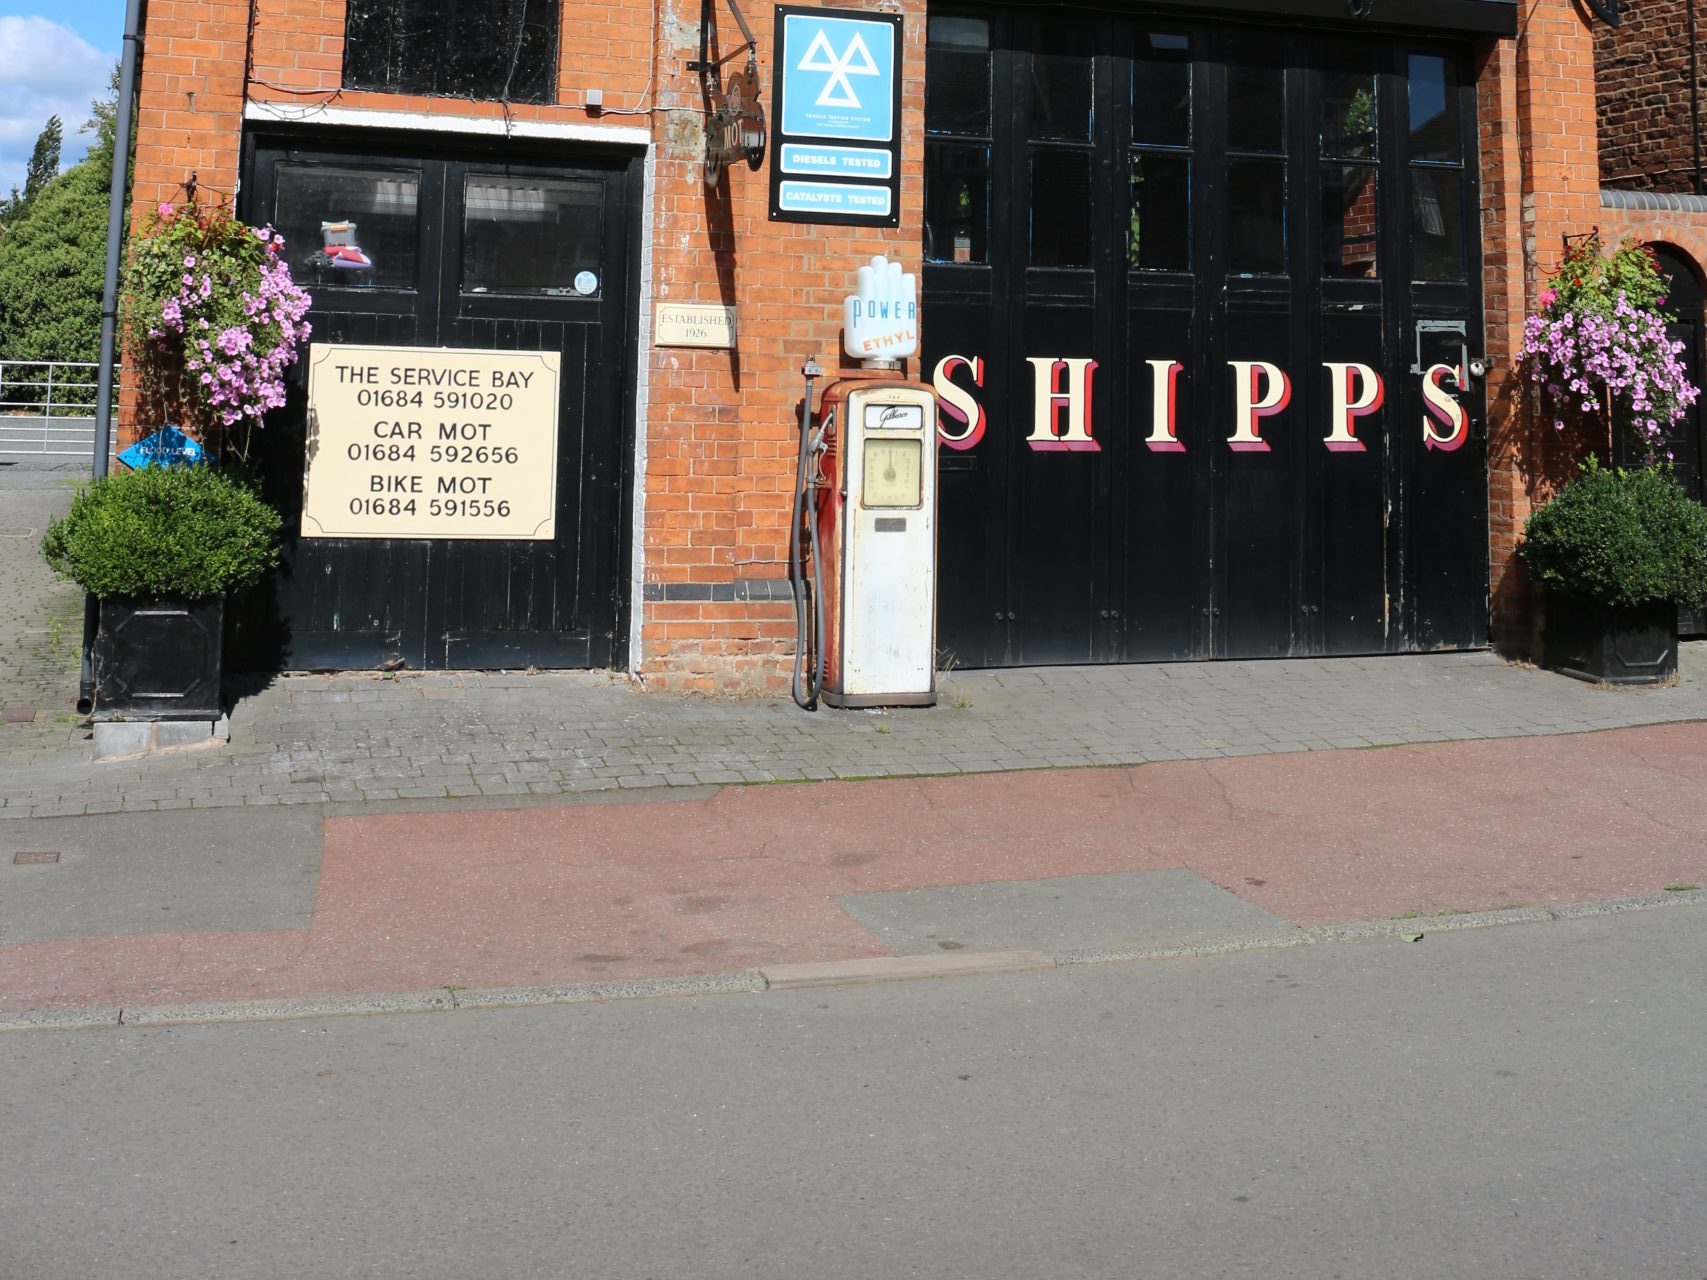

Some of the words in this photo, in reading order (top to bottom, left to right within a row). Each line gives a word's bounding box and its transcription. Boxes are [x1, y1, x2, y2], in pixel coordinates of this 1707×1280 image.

[724, 119, 744, 150] MOT
[792, 154, 837, 166] DIESELS
[842, 157, 881, 168] TESTED
[785, 191, 842, 203] CATALYSTS
[848, 195, 885, 206] TESTED
[662, 314, 732, 326] ESTABLISHED
[853, 299, 916, 328] POWER
[685, 328, 707, 338] 1926
[863, 330, 915, 352] ETHYL
[335, 366, 379, 384] THE
[390, 367, 480, 387] SERVICE
[492, 370, 535, 389] BAY
[357, 389, 423, 408] 01684
[433, 391, 513, 410] 591020
[933, 355, 1469, 452] SHIPPS
[373, 421, 422, 439] CAR
[438, 423, 492, 441] MOT
[140, 446, 168, 455] FLOOD
[171, 447, 196, 456] LEVEL
[347, 443, 416, 462] 01684
[430, 445, 519, 464] 592656
[370, 475, 423, 493] BIKE
[437, 477, 492, 494] MOT
[350, 498, 416, 516] 01684
[429, 499, 511, 518] 591556
